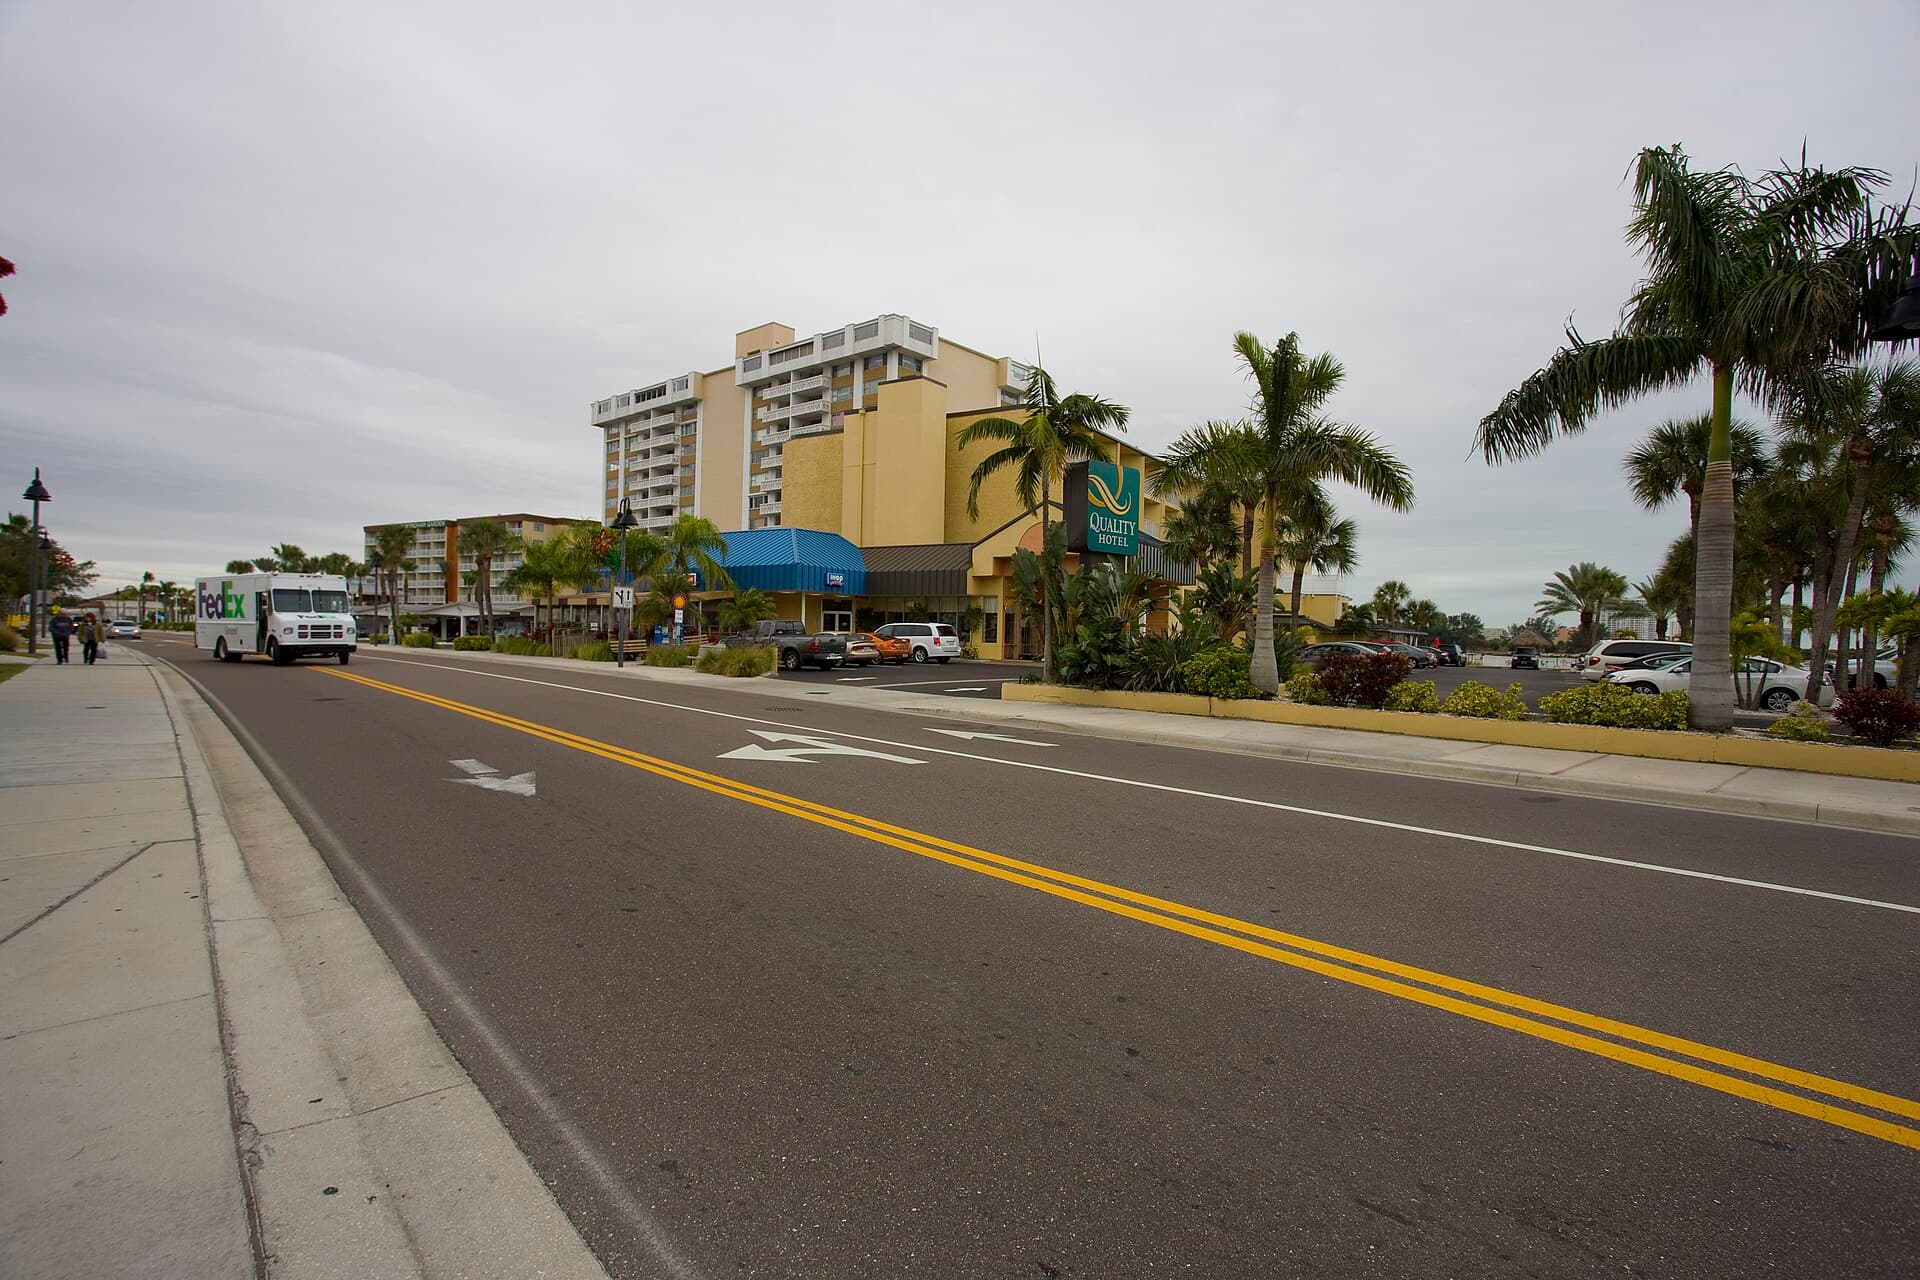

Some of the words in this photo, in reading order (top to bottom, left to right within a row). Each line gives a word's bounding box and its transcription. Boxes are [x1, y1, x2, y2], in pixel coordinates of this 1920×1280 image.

[1090, 512, 1136, 536] QUALITY
[1098, 533, 1129, 547] HOTEL
[198, 580, 246, 619] FedEx
